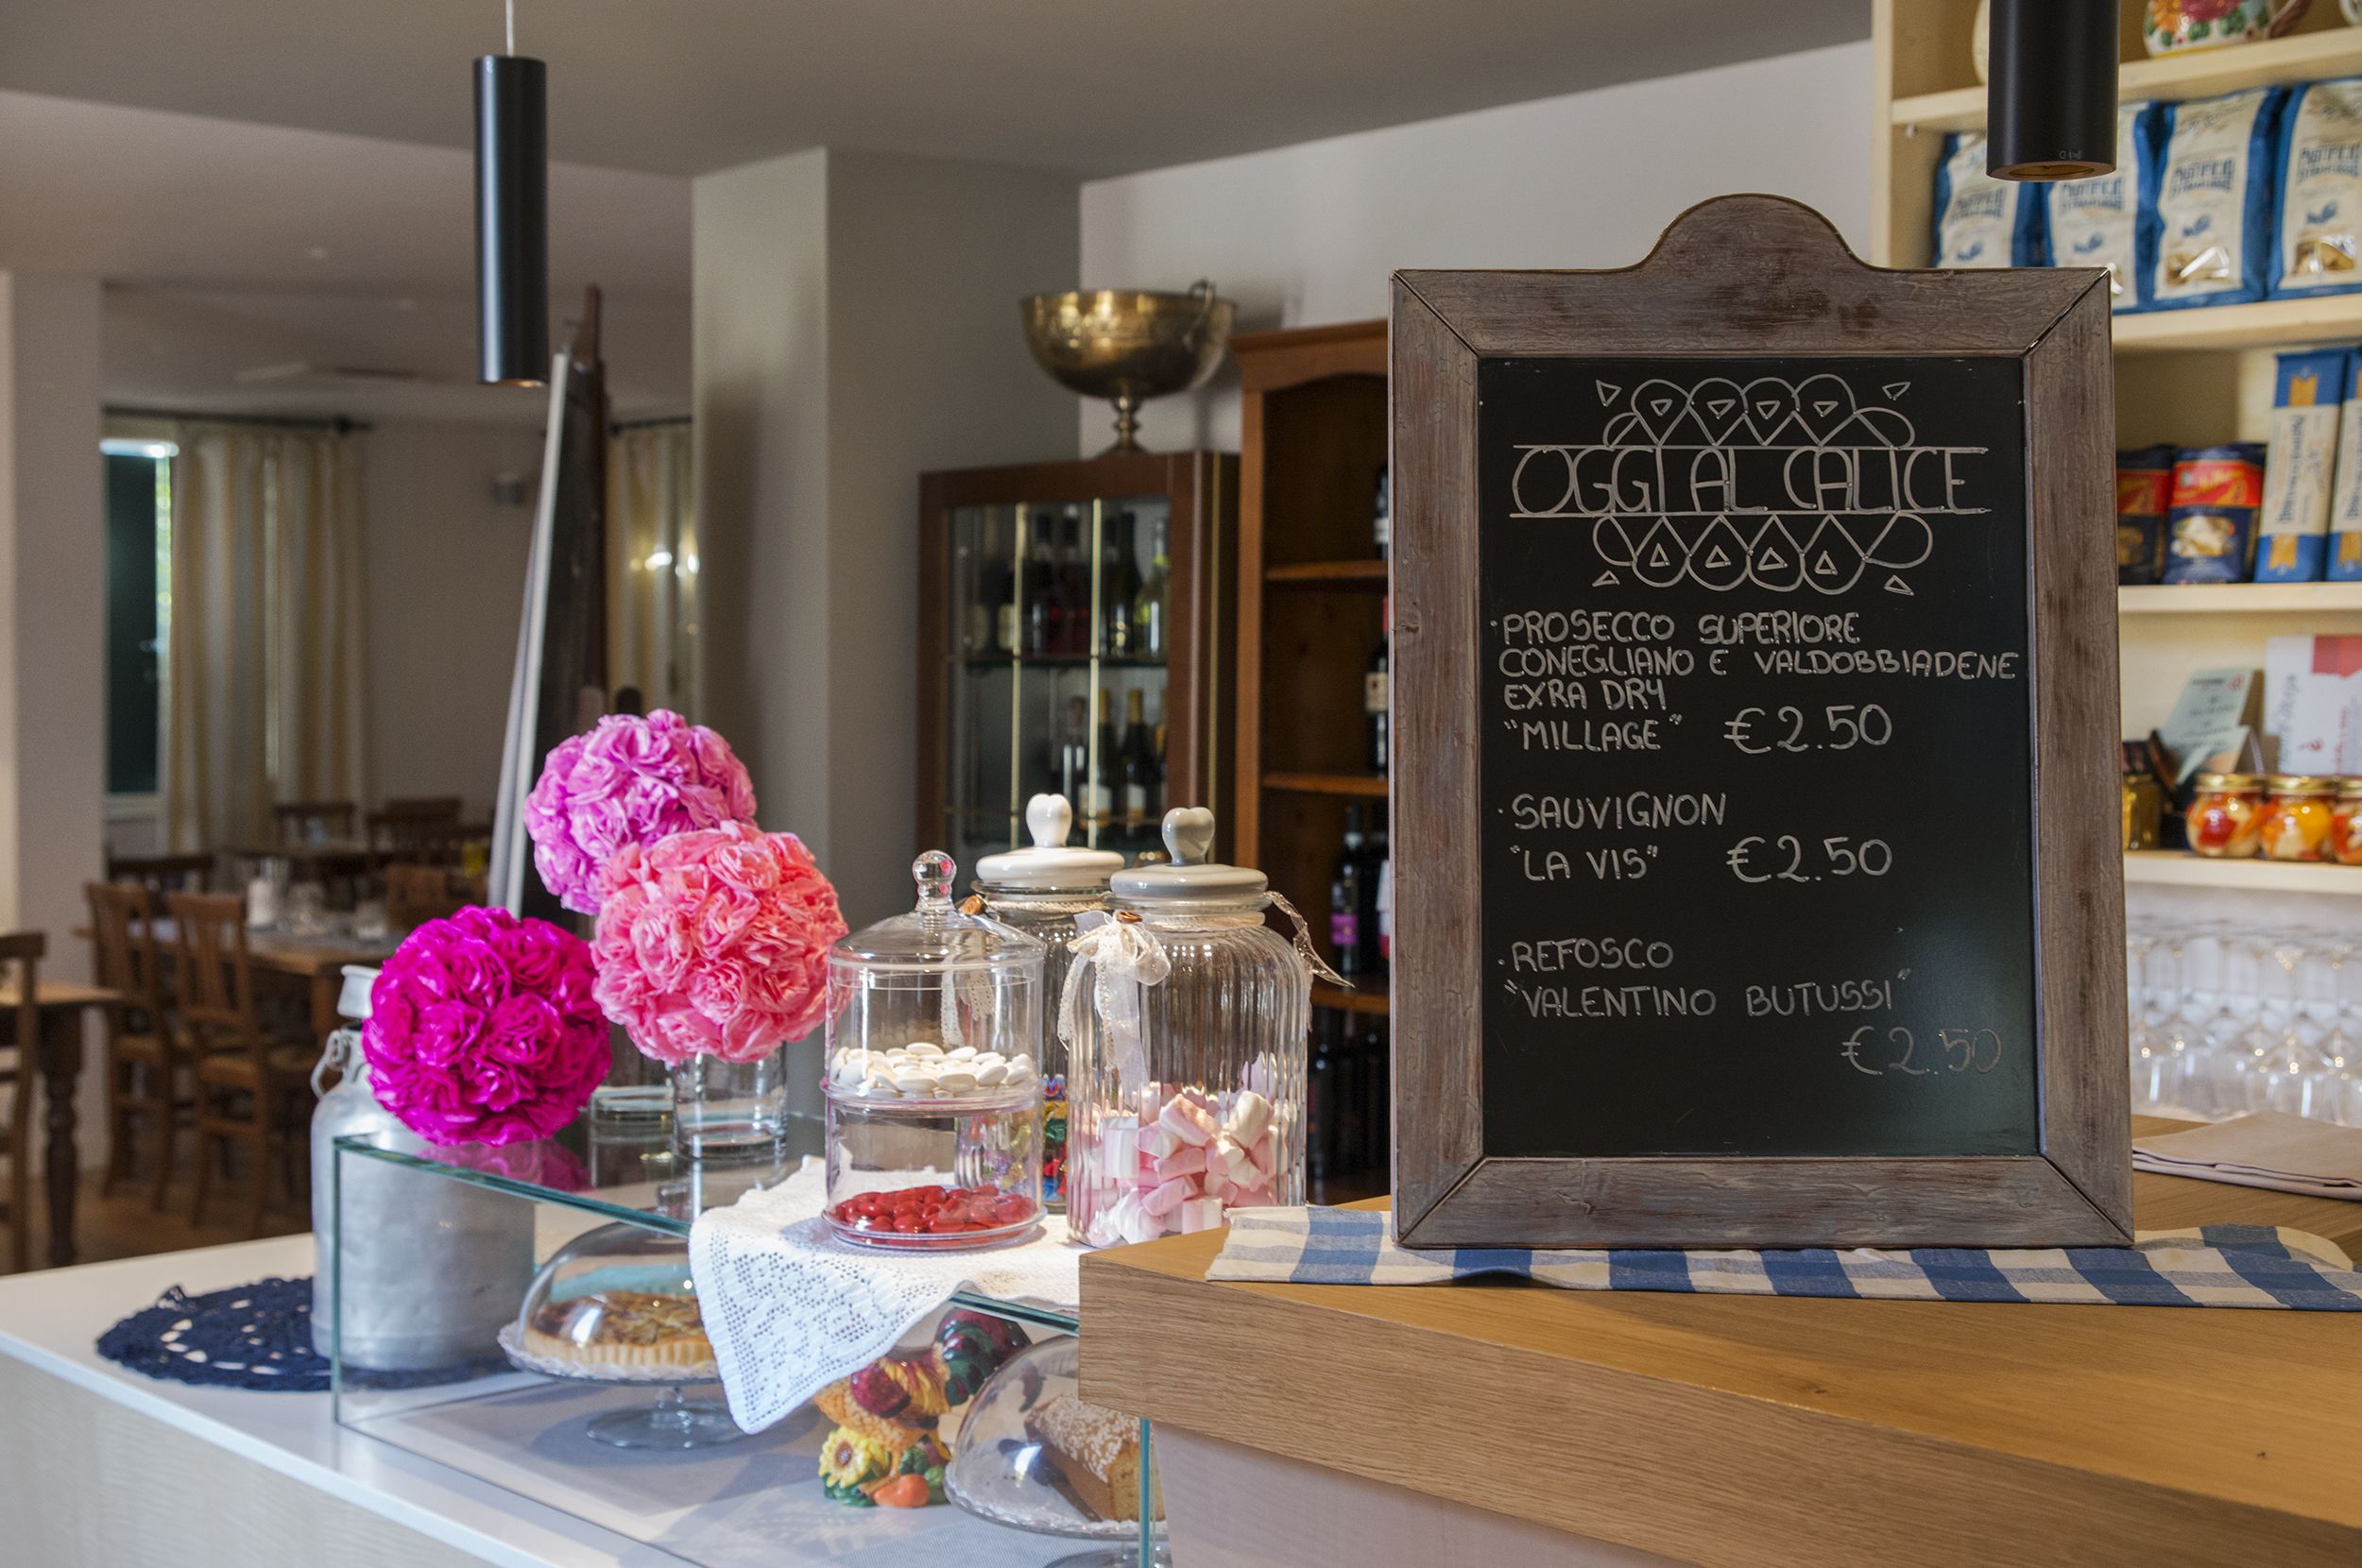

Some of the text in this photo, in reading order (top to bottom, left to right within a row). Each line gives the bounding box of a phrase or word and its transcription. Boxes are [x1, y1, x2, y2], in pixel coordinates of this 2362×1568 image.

[1511, 444, 1988, 517] OGGI AL CALICE
[1698, 610, 1861, 644] SUPERIORE
[1498, 646, 2020, 680] CONEGLIANO E VALDOBBIADENE
[1503, 677, 1667, 711] EXRA DRY
